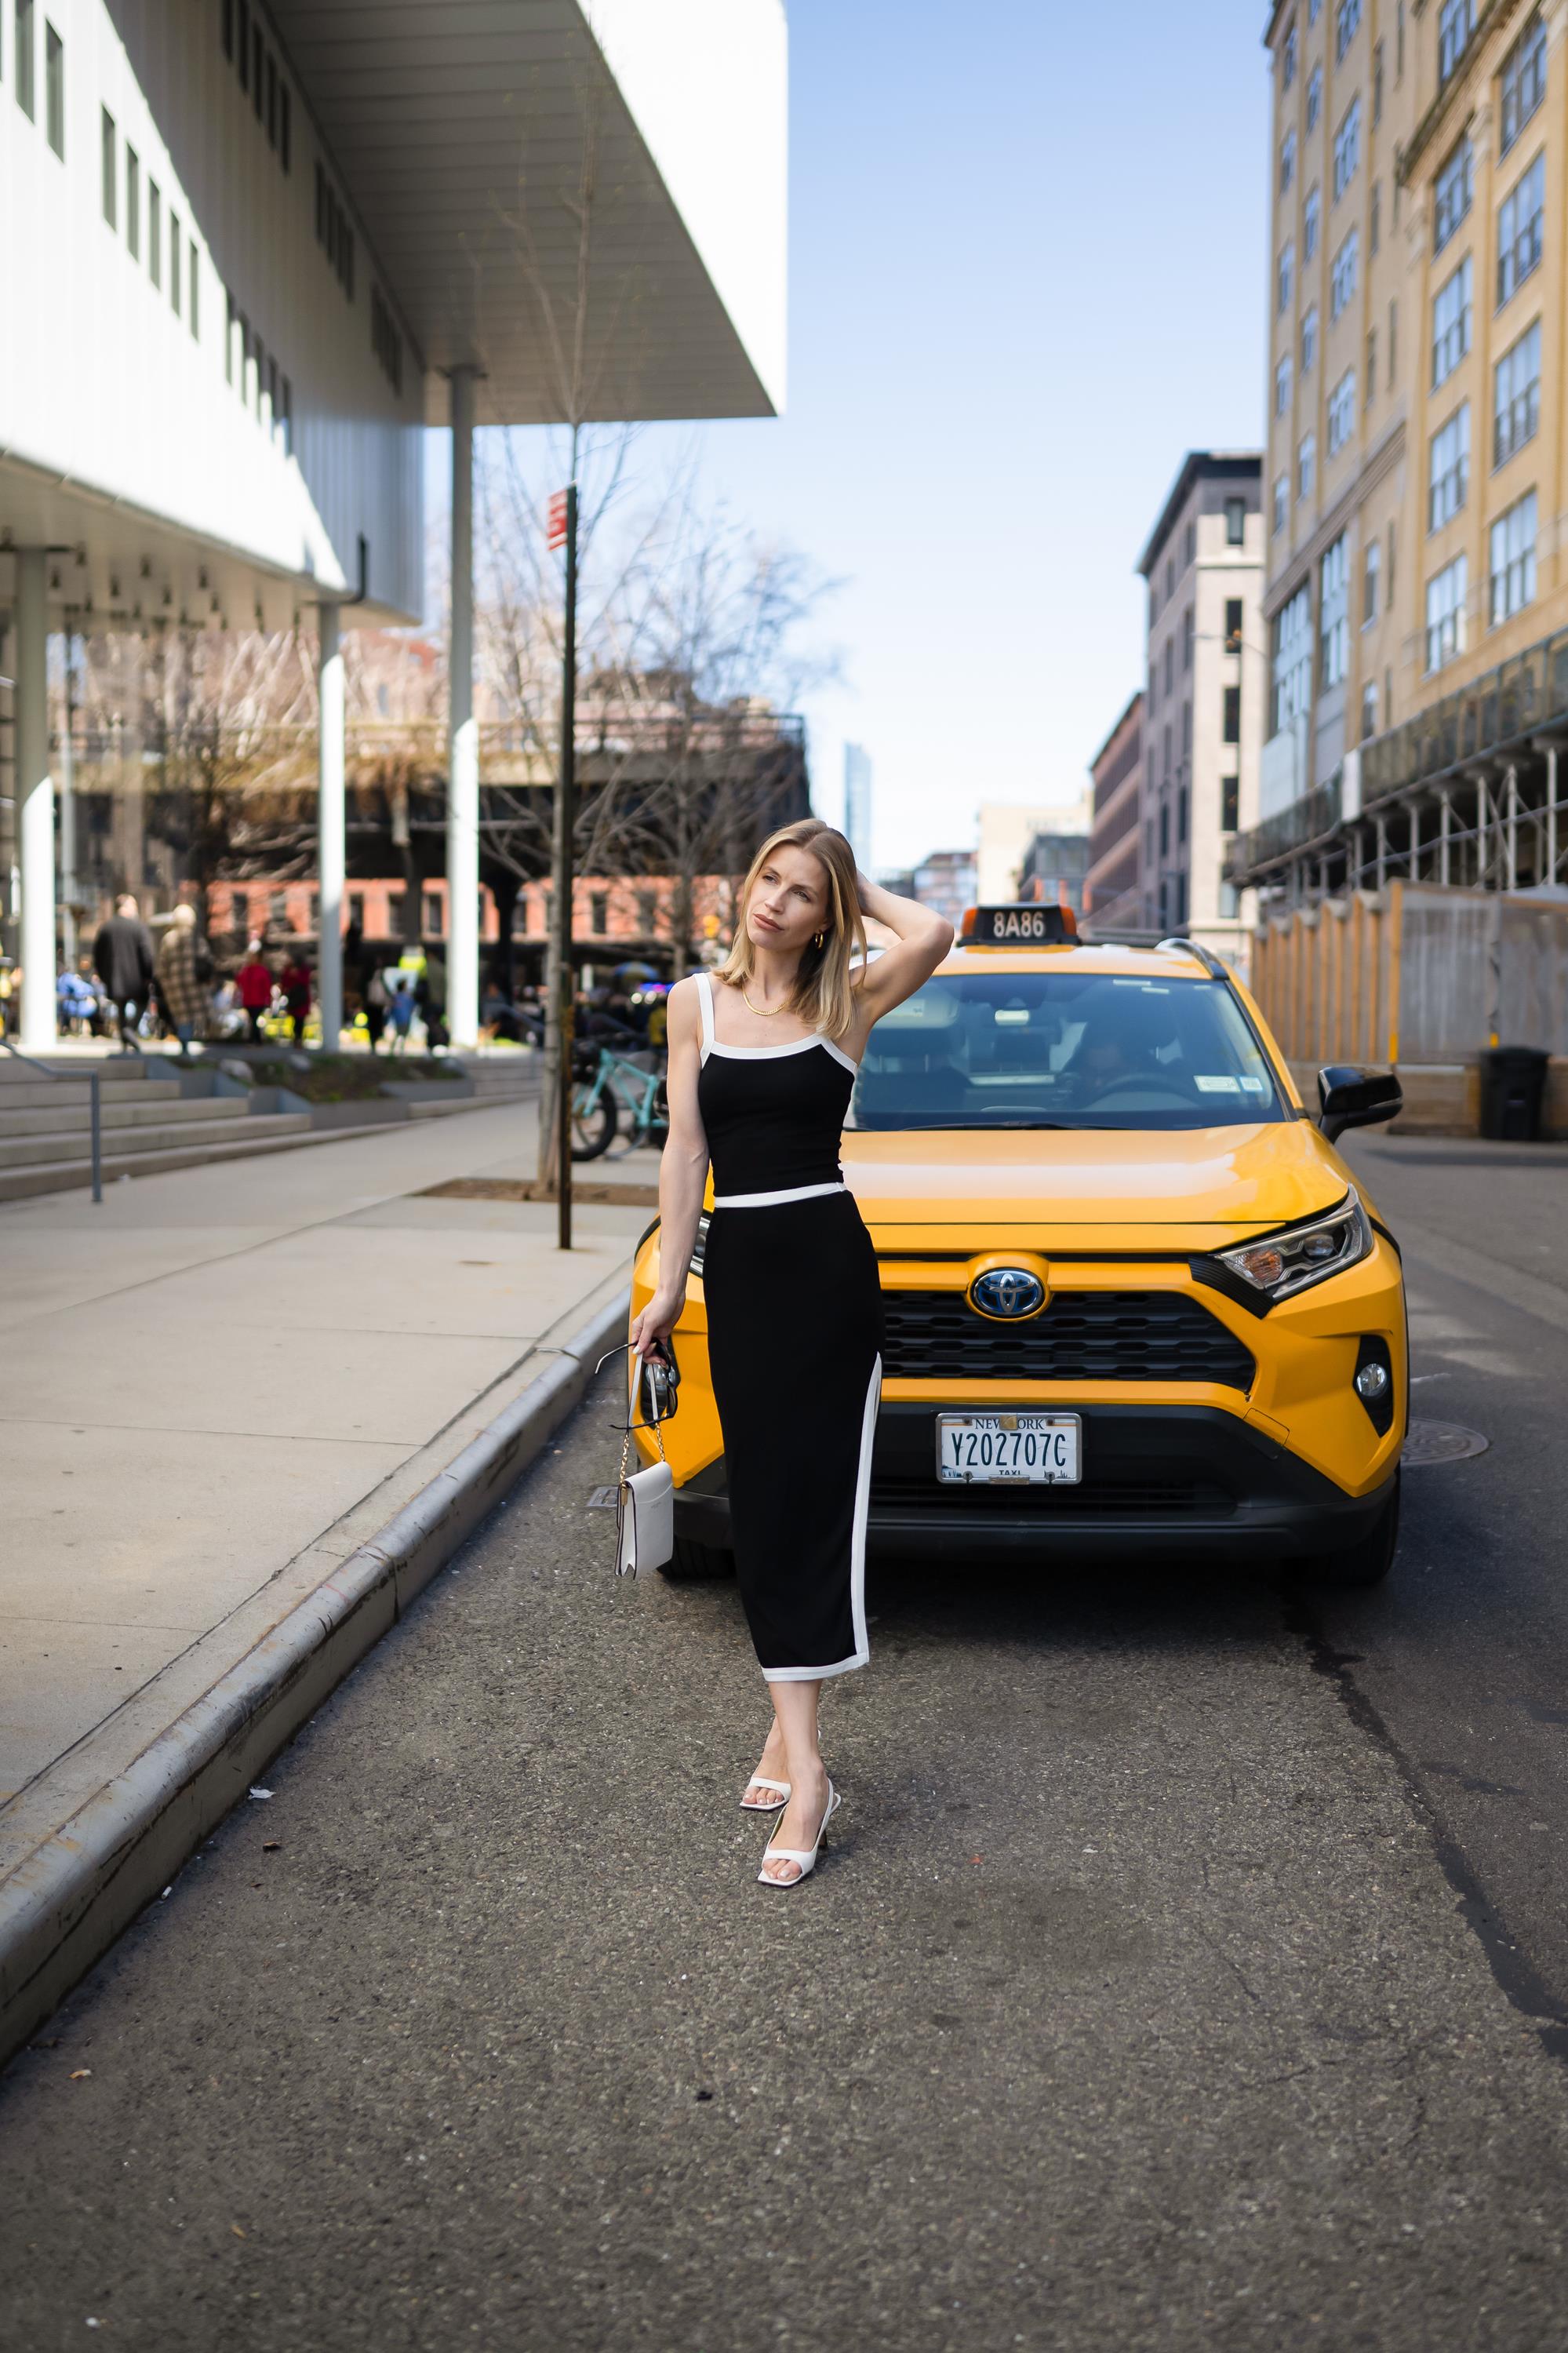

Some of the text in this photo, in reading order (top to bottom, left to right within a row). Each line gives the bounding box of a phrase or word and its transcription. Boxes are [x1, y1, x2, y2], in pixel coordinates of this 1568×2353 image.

[993, 911, 1044, 938] 8A86
[1017, 1419, 1045, 1430] ORK
[951, 1433, 1066, 1466] Y202707C
